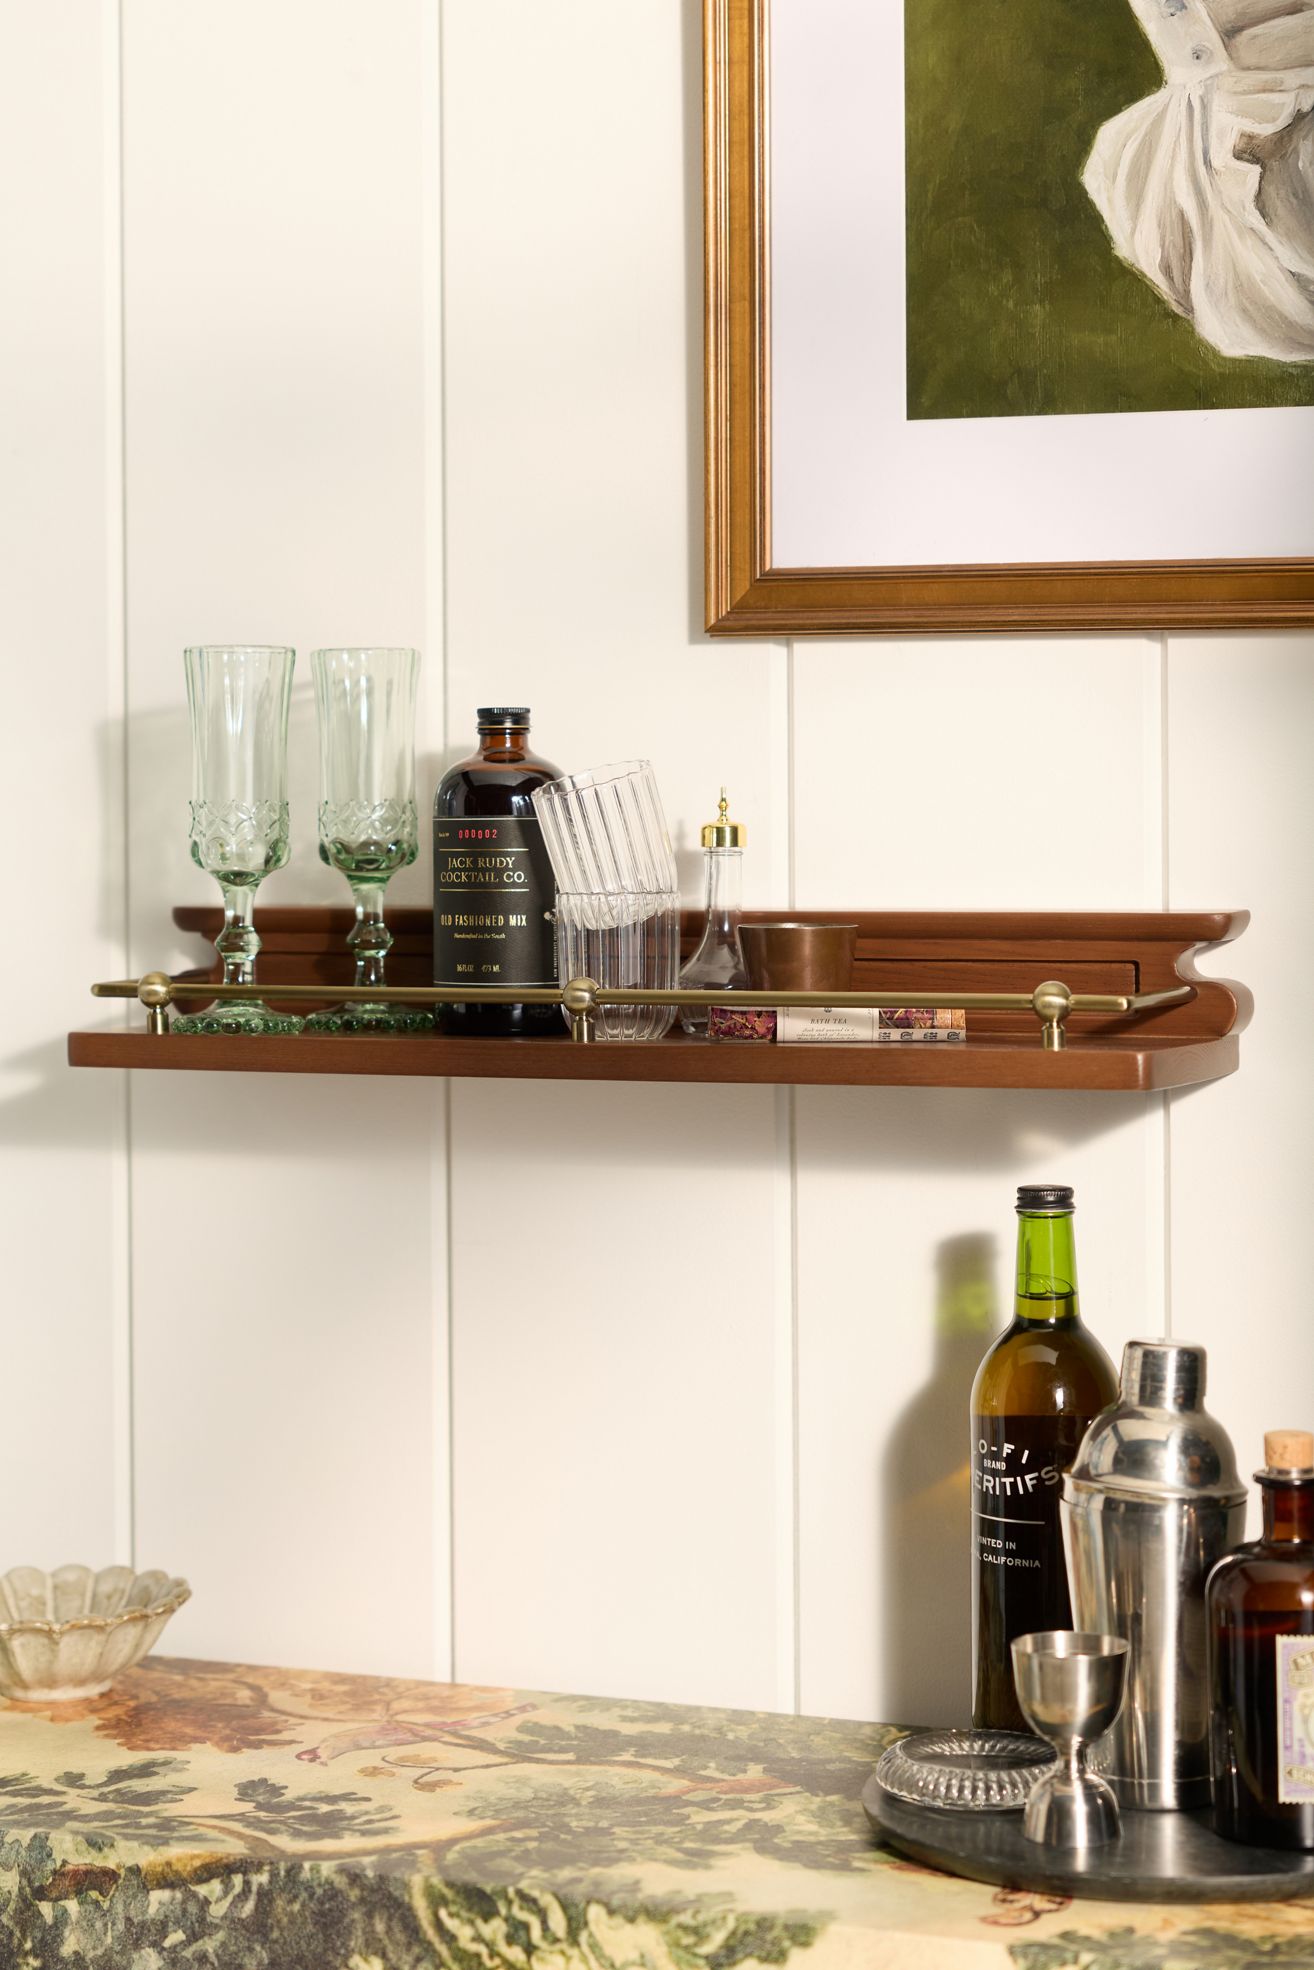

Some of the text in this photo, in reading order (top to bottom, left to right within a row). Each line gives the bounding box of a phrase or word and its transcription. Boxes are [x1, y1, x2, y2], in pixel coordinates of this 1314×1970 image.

[448, 857, 515, 869] JACK RUDY
[440, 871, 528, 883] COCKTAIL CO.
[440, 914, 527, 927] OLD FASHIONED MIX
[978, 1439, 1029, 1465] O-FI
[983, 1458, 1007, 1471] BRAND
[974, 1466, 1060, 1496] ERITIFS
[1005, 1541, 1017, 1550] IN
[982, 1552, 1041, 1568] CALIFORNIA
